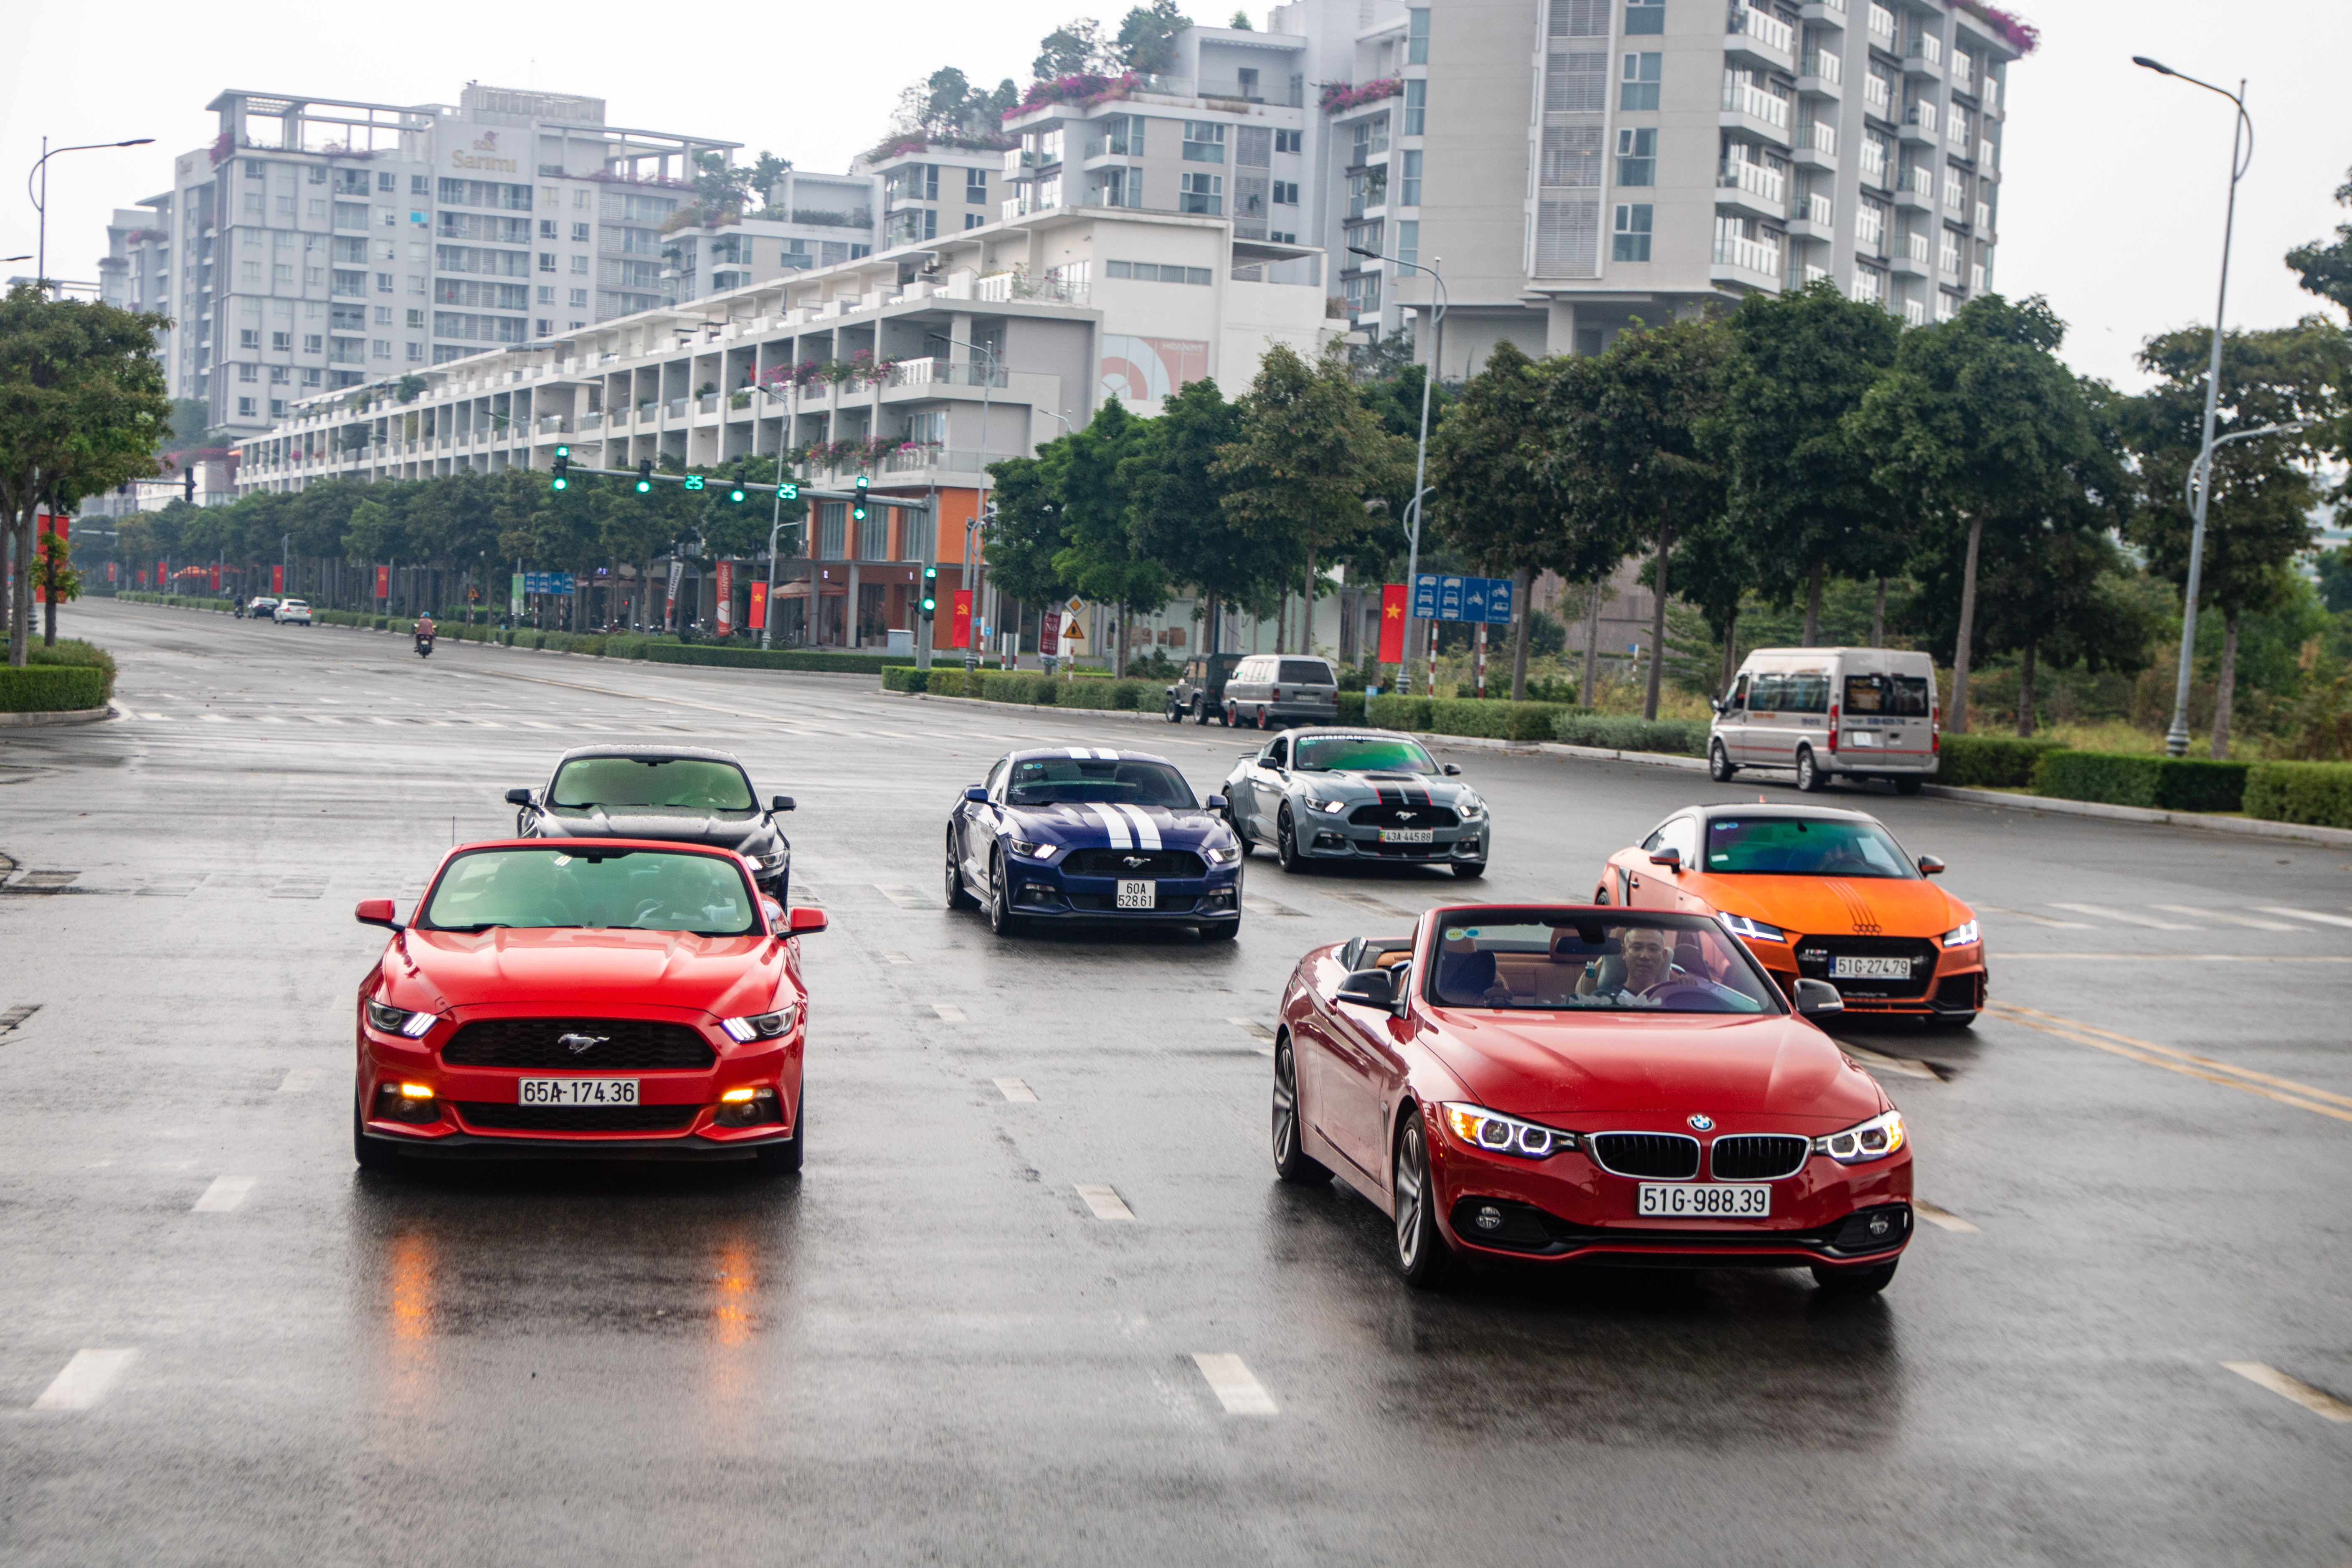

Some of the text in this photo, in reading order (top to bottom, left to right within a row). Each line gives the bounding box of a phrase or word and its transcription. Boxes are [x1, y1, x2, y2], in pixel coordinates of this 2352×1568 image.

[685, 475, 703, 489] 25
[779, 484, 797, 499] 25
[1127, 883, 1146, 894] 60A
[1118, 895, 1151, 907] 528.61
[524, 1082, 634, 1102] 65A-174.36
[1644, 1188, 1766, 1212] 51G-988.39
